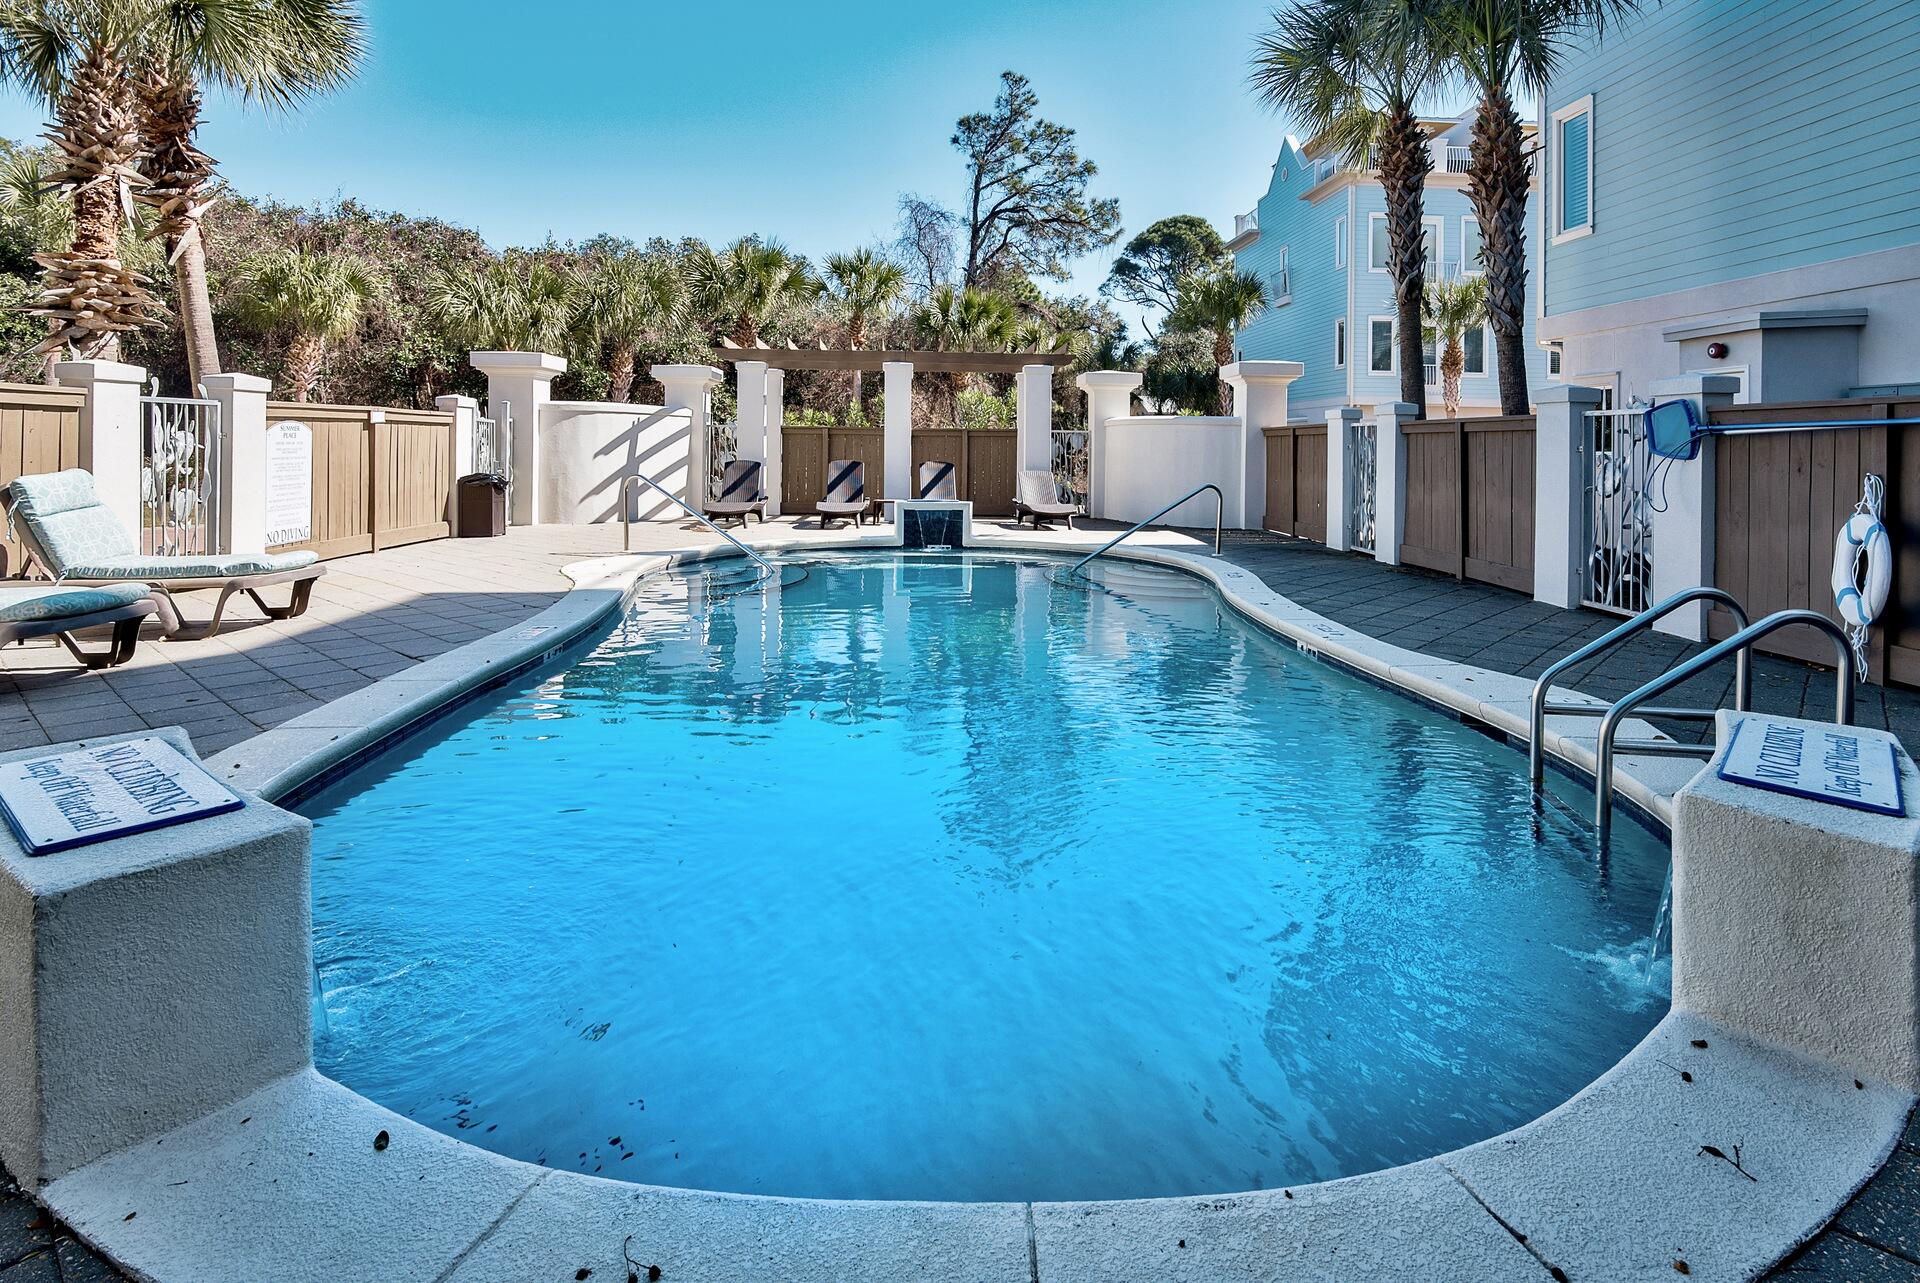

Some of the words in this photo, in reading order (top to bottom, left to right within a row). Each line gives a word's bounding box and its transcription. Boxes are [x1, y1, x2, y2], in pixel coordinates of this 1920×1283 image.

[266, 530, 280, 544] NO
[281, 525, 309, 542] DIVING
[89, 744, 141, 764] NO
[1760, 723, 1805, 767] CLIMBING
[1824, 732, 1860, 762] Waterfall
[20, 758, 63, 780] Keep
[1755, 765, 1800, 785] NO
[1823, 759, 1860, 776] Off
[39, 775, 90, 793] Off
[104, 759, 200, 815] CLIMBING
[1824, 775, 1873, 797] Keep
[50, 786, 123, 832] Waterfall
